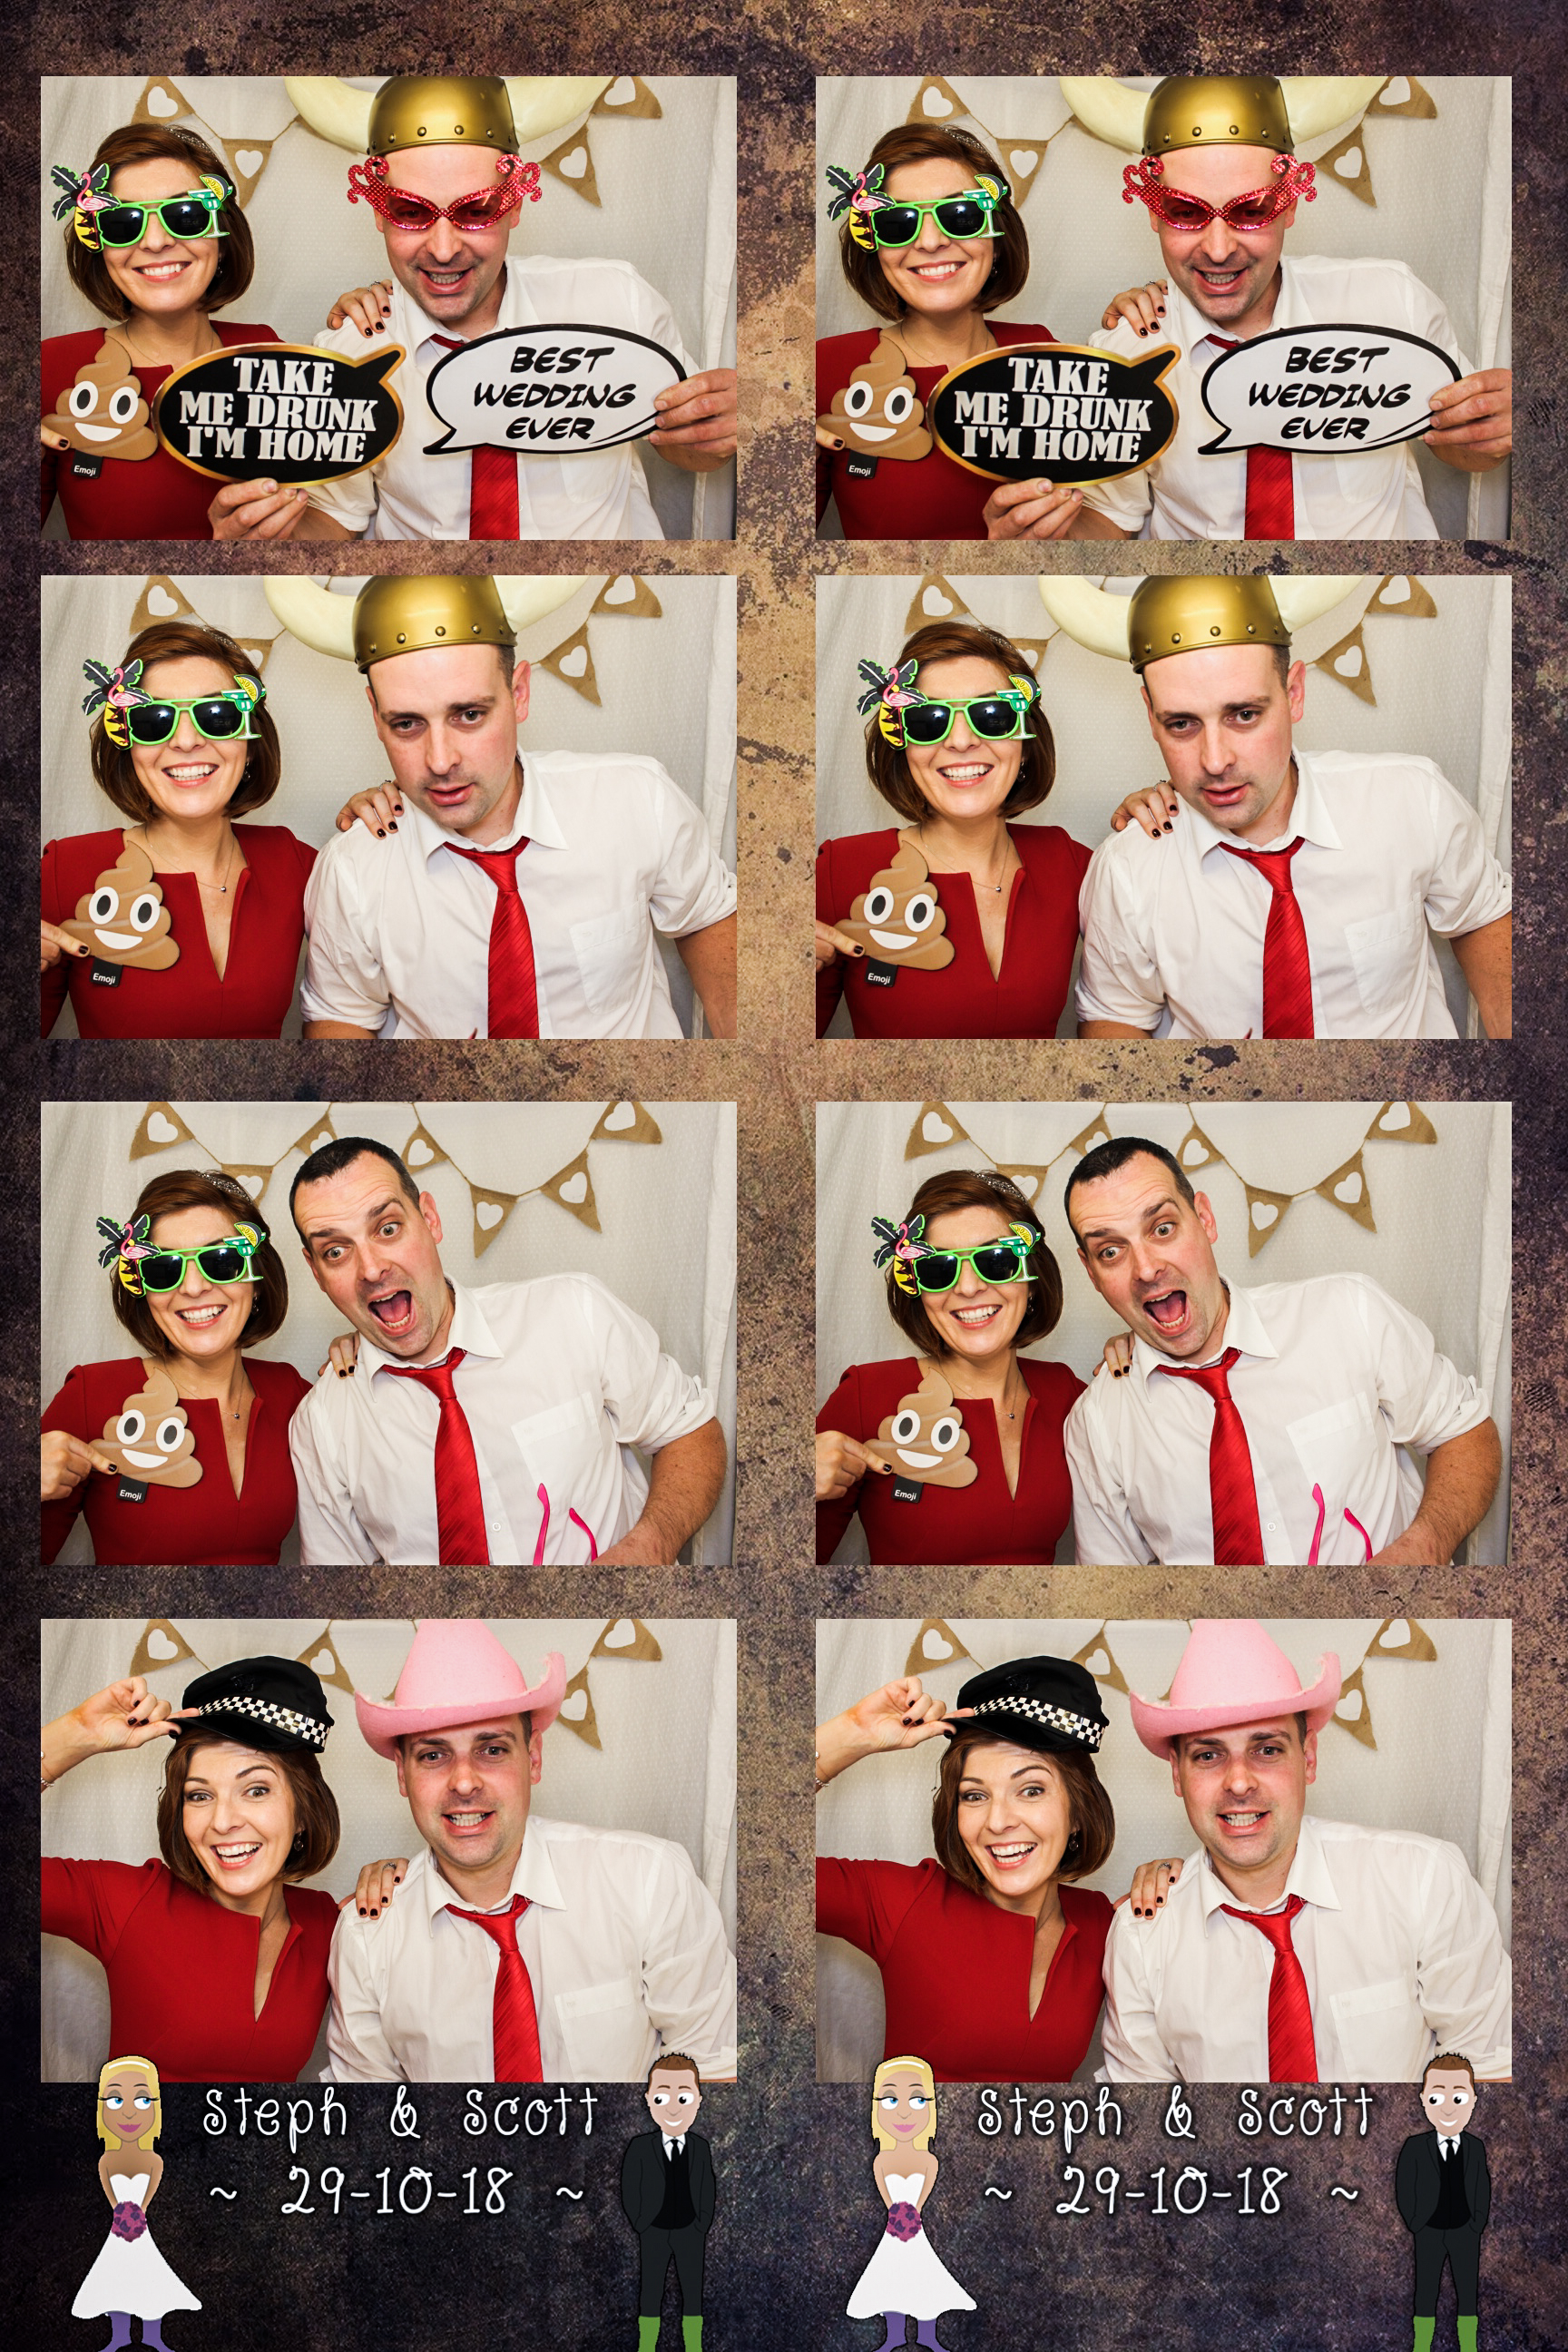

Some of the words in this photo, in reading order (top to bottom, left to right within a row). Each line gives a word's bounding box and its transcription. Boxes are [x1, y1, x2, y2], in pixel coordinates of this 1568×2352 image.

[510, 346, 615, 374] BEST
[1285, 346, 1390, 374] BEST
[233, 357, 335, 397] TAKE
[1008, 357, 1110, 397] TAKE
[474, 382, 636, 408] WEDDING
[1249, 382, 1411, 408] WEDDING
[179, 390, 235, 426] ME
[245, 394, 378, 431] DRUNK
[954, 390, 1010, 426] ME
[1020, 394, 1153, 431] DRUNK
[505, 416, 595, 440] EVER
[1280, 416, 1370, 440] EVER
[186, 426, 248, 459] I'M
[257, 428, 367, 463] HOME
[961, 426, 1023, 459] I'M
[1032, 428, 1142, 463] HOME
[74, 465, 97, 477] Emoji
[848, 465, 872, 477] Emoji
[93, 972, 116, 985] Emoji
[867, 972, 891, 985] Emoji
[119, 1489, 142, 1502] Emoji
[894, 1489, 917, 1502] Emoji
